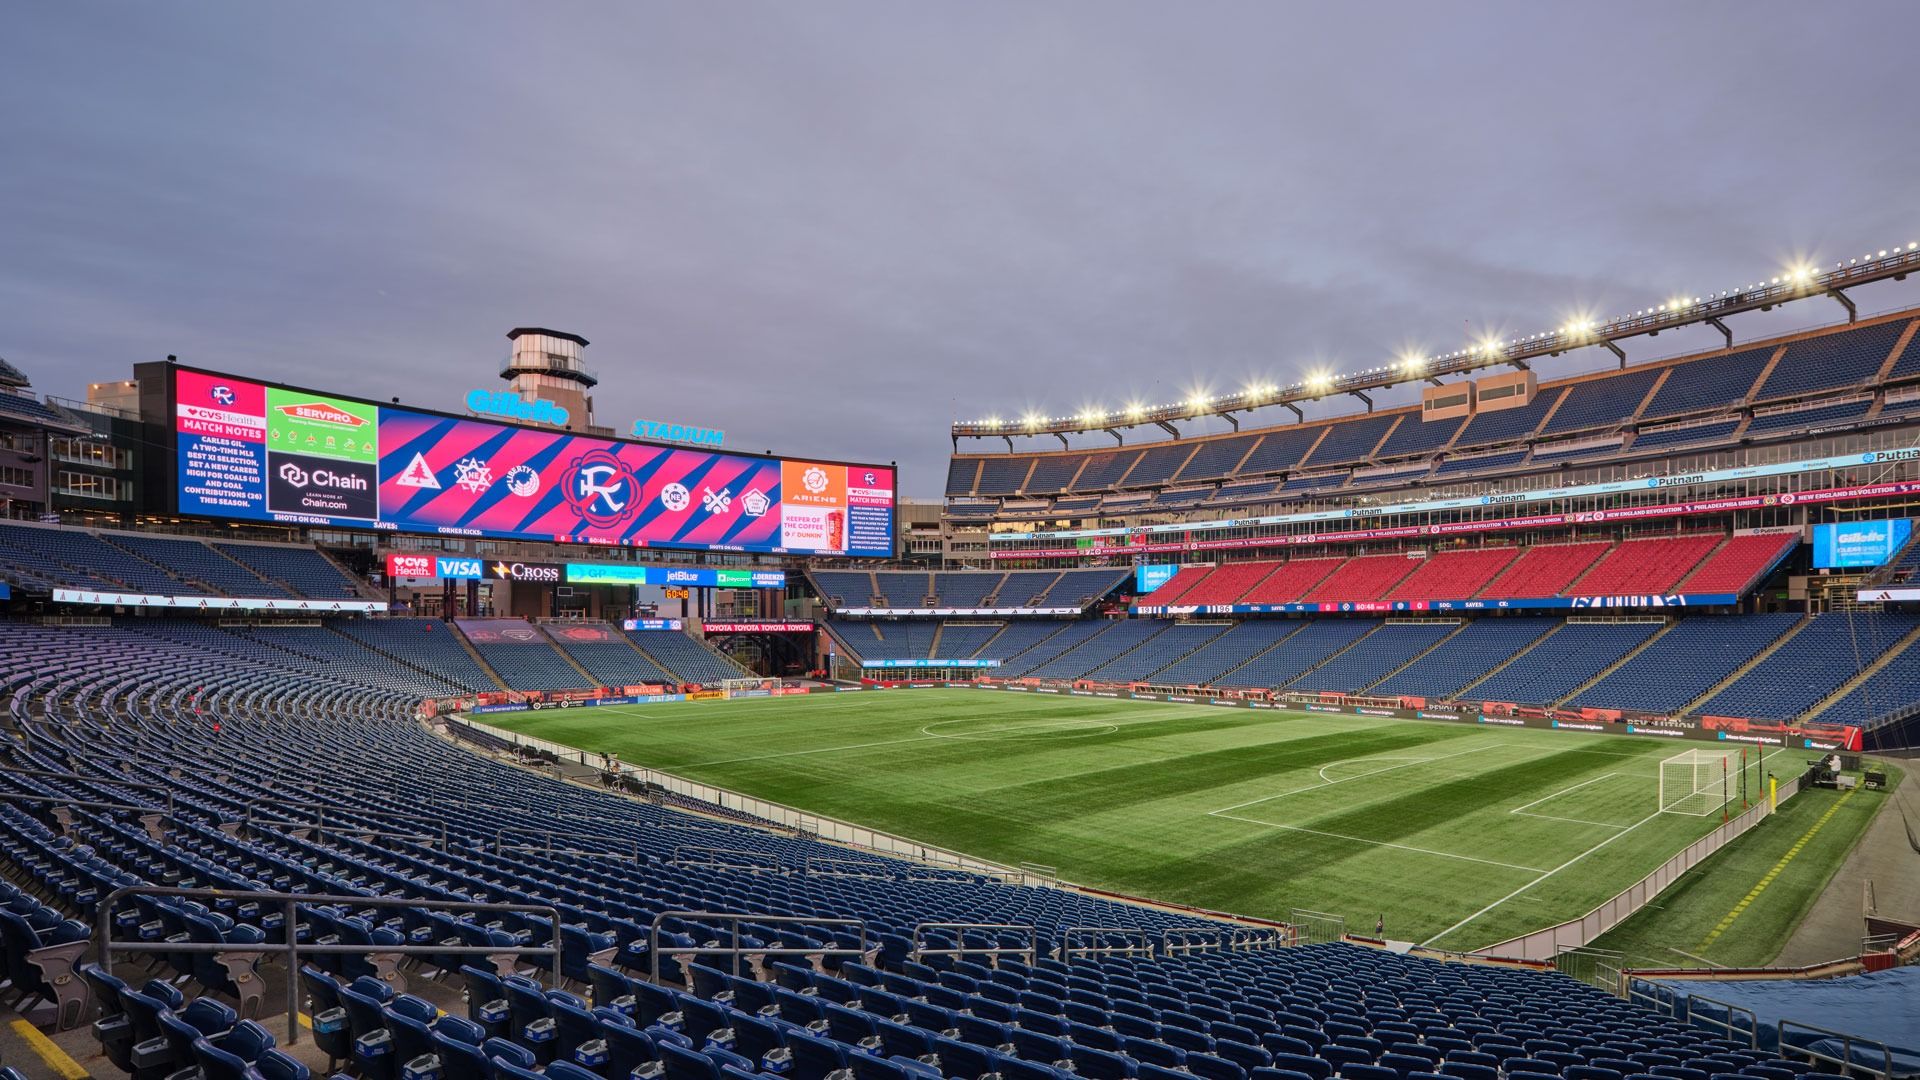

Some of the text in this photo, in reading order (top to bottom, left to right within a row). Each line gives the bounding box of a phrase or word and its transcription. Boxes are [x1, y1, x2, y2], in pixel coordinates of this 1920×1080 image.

[466, 389, 569, 426] Gillette
[184, 420, 262, 439] MATCH NOTES
[632, 419, 723, 445] STADIUM
[202, 436, 230, 445] CARLES
[200, 444, 238, 454] TWO-TIME
[187, 451, 207, 460] BEST
[217, 455, 259, 467] SELECTION,
[186, 469, 206, 477] HIGH
[224, 473, 247, 482] GOALS
[229, 466, 258, 475] CAREER
[506, 465, 532, 484] LIBERTY
[312, 470, 367, 490] Chain
[1659, 475, 1704, 486] Putnam
[223, 482, 243, 490] GOAL
[184, 486, 246, 498] CONTRIBUTIONS
[1815, 492, 1848, 500] ENGLAND
[218, 498, 251, 508] SEASON.
[792, 494, 837, 503] ARIENS
[1490, 493, 1526, 503] Putnam
[302, 498, 347, 510] Chain.com
[1693, 502, 1738, 511] PHILADELPHIA
[373, 522, 398, 530] SAVES:
[438, 527, 463, 535] CORNER
[404, 558, 428, 567] CVS
[438, 560, 481, 576] VISA
[666, 570, 698, 582] jetBlue
[666, 590, 689, 599] 60:48
[1607, 596, 1648, 607] UNION
